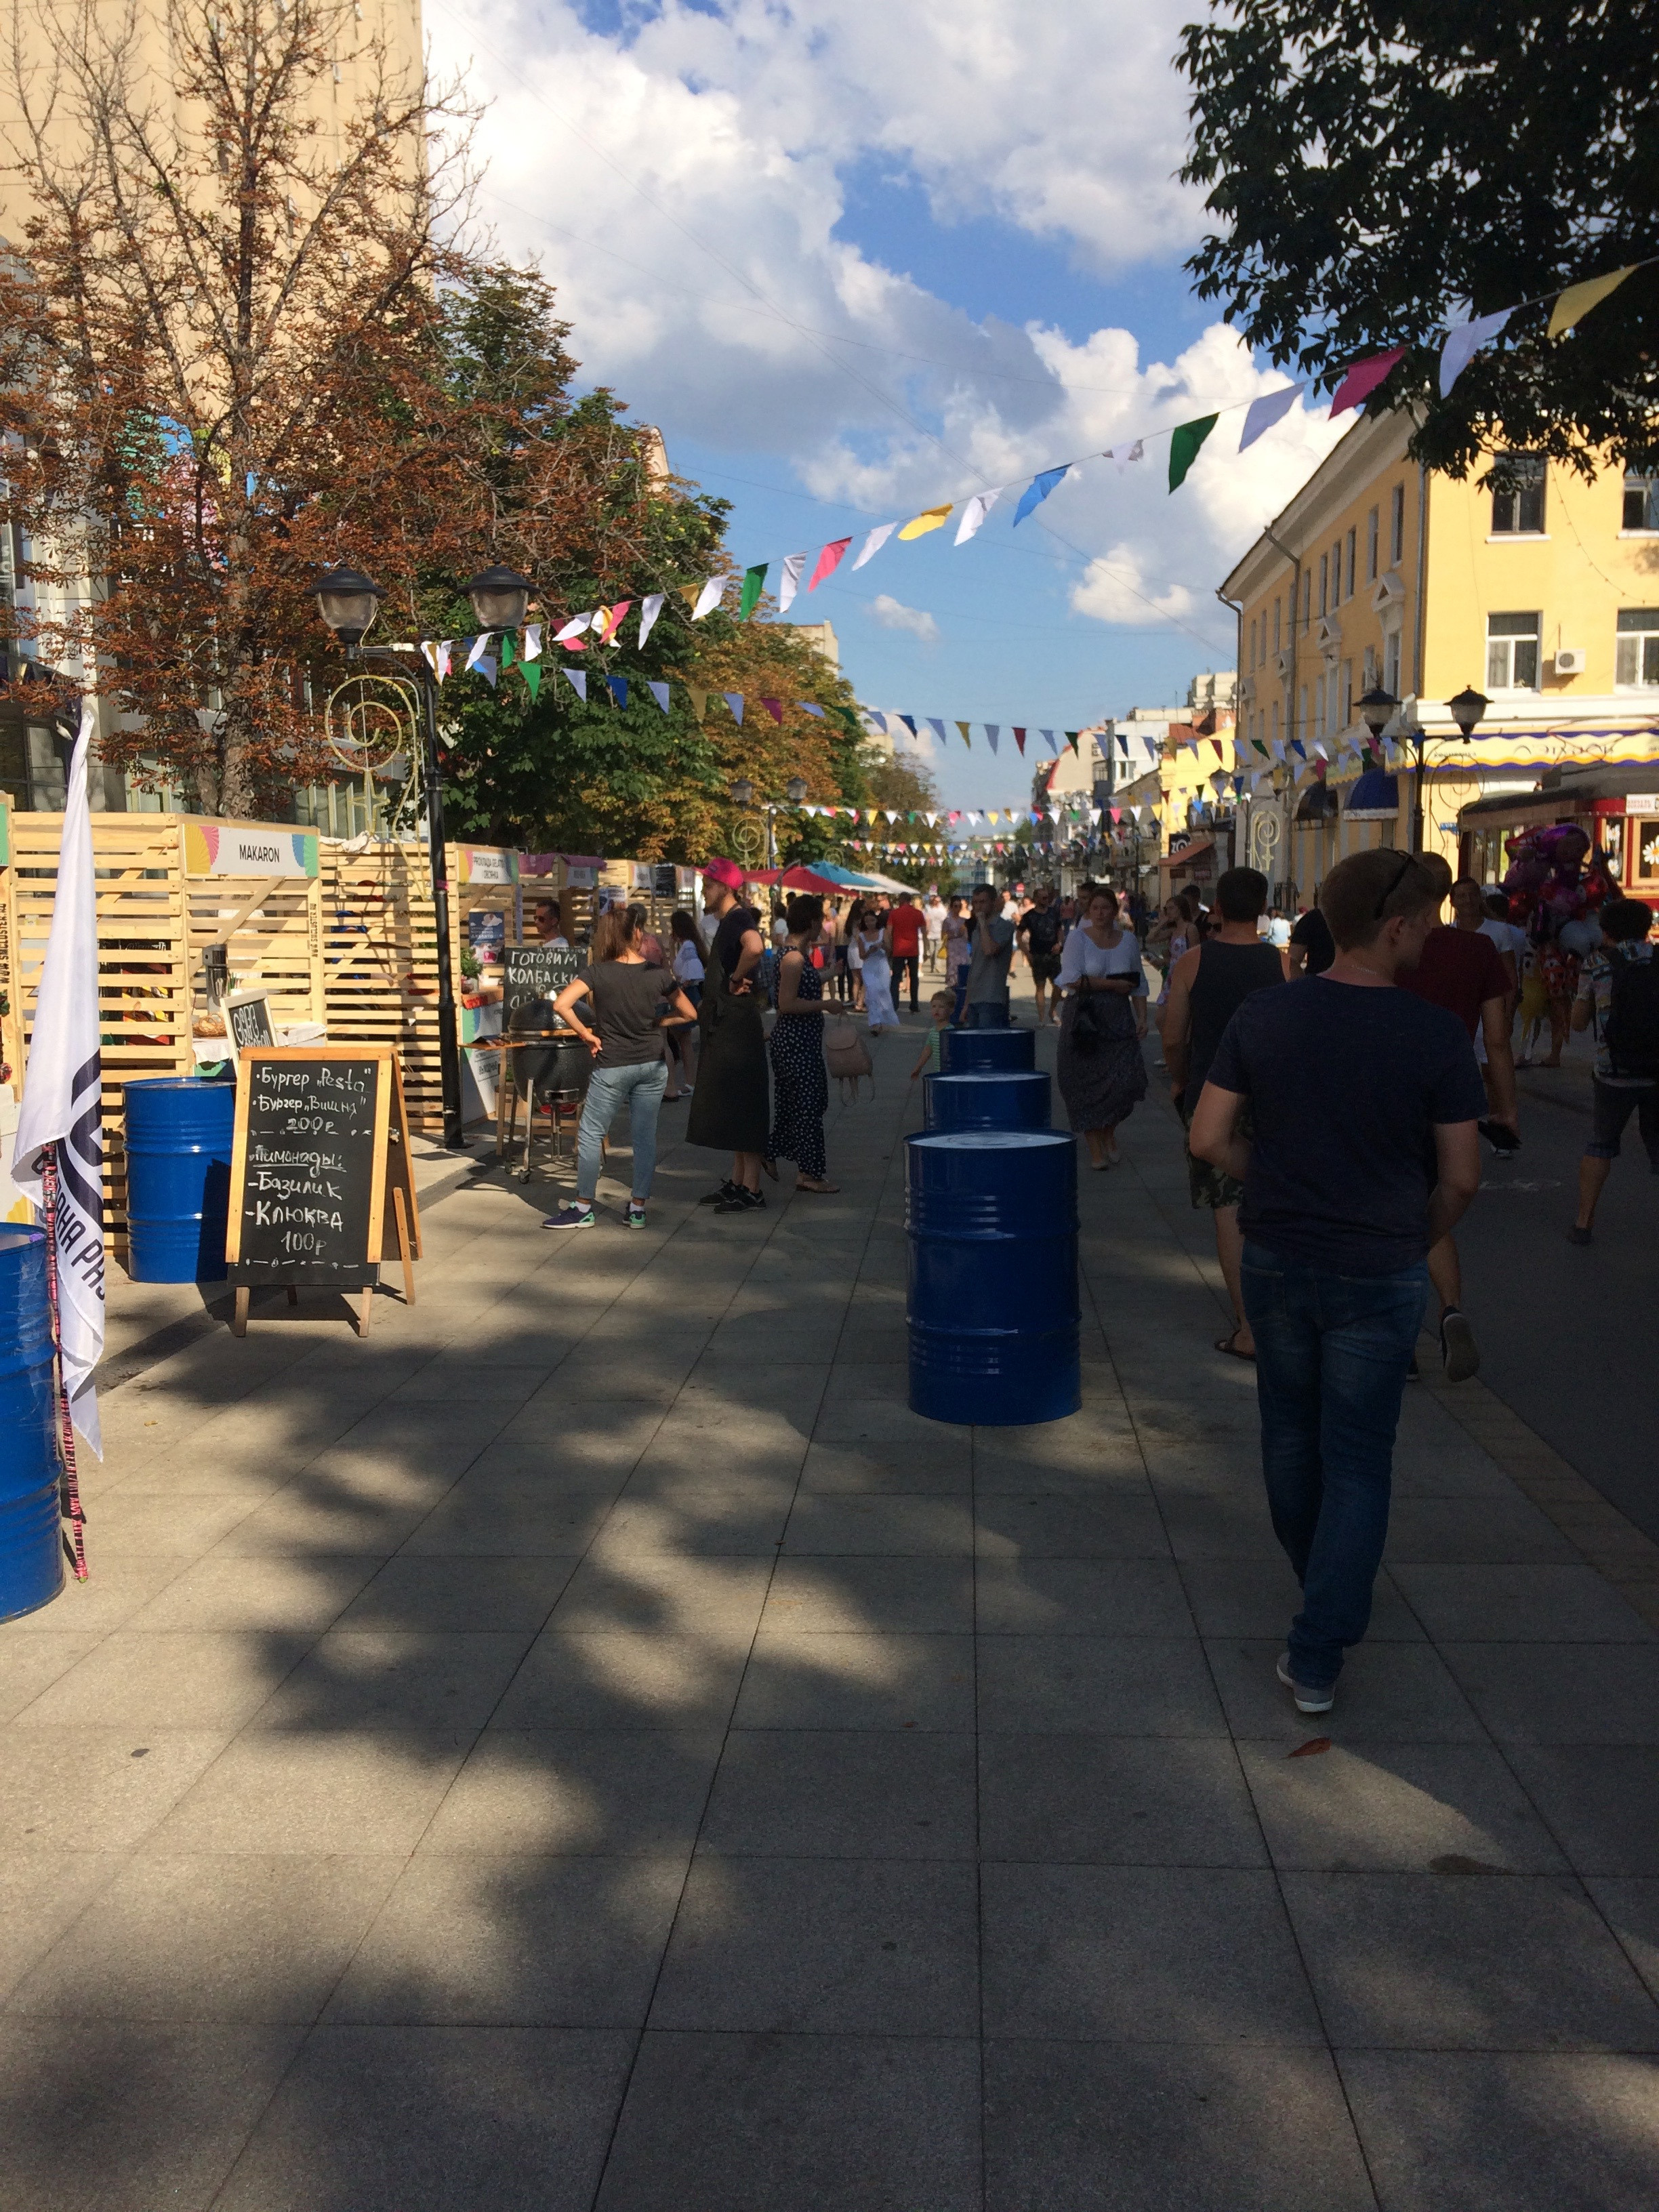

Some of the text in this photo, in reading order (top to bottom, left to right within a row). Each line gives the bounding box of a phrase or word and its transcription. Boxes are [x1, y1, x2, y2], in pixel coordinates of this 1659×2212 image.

[239, 844, 279, 863] MAKARON
[511, 951, 577, 967] ГОТОВИМ
[262, 1067, 310, 1094] Бургер
[258, 1094, 302, 1113] Бургер
